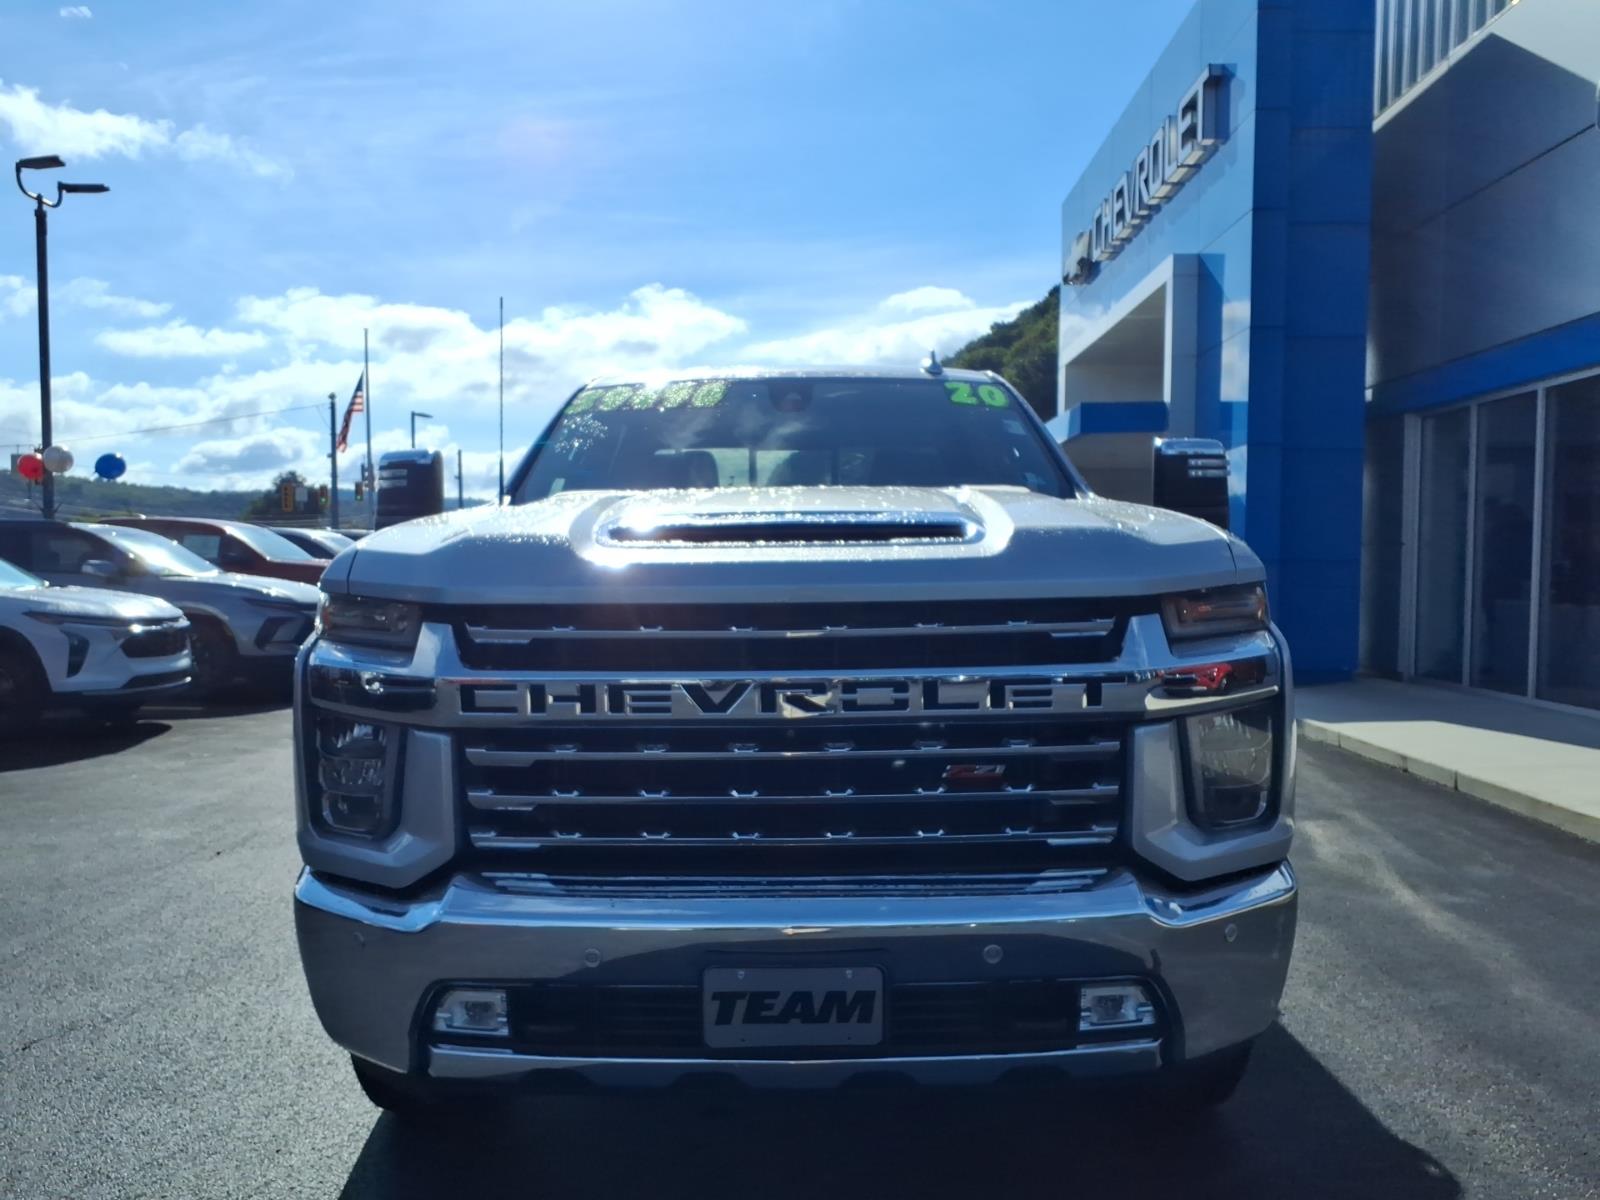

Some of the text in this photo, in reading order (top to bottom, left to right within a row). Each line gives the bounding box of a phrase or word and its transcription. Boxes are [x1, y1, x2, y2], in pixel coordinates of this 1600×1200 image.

[1090, 62, 1237, 263] CHEVROLET
[944, 381, 1008, 407] 20
[459, 678, 1127, 715] CHEVROLET
[711, 990, 876, 1025] TEAM
